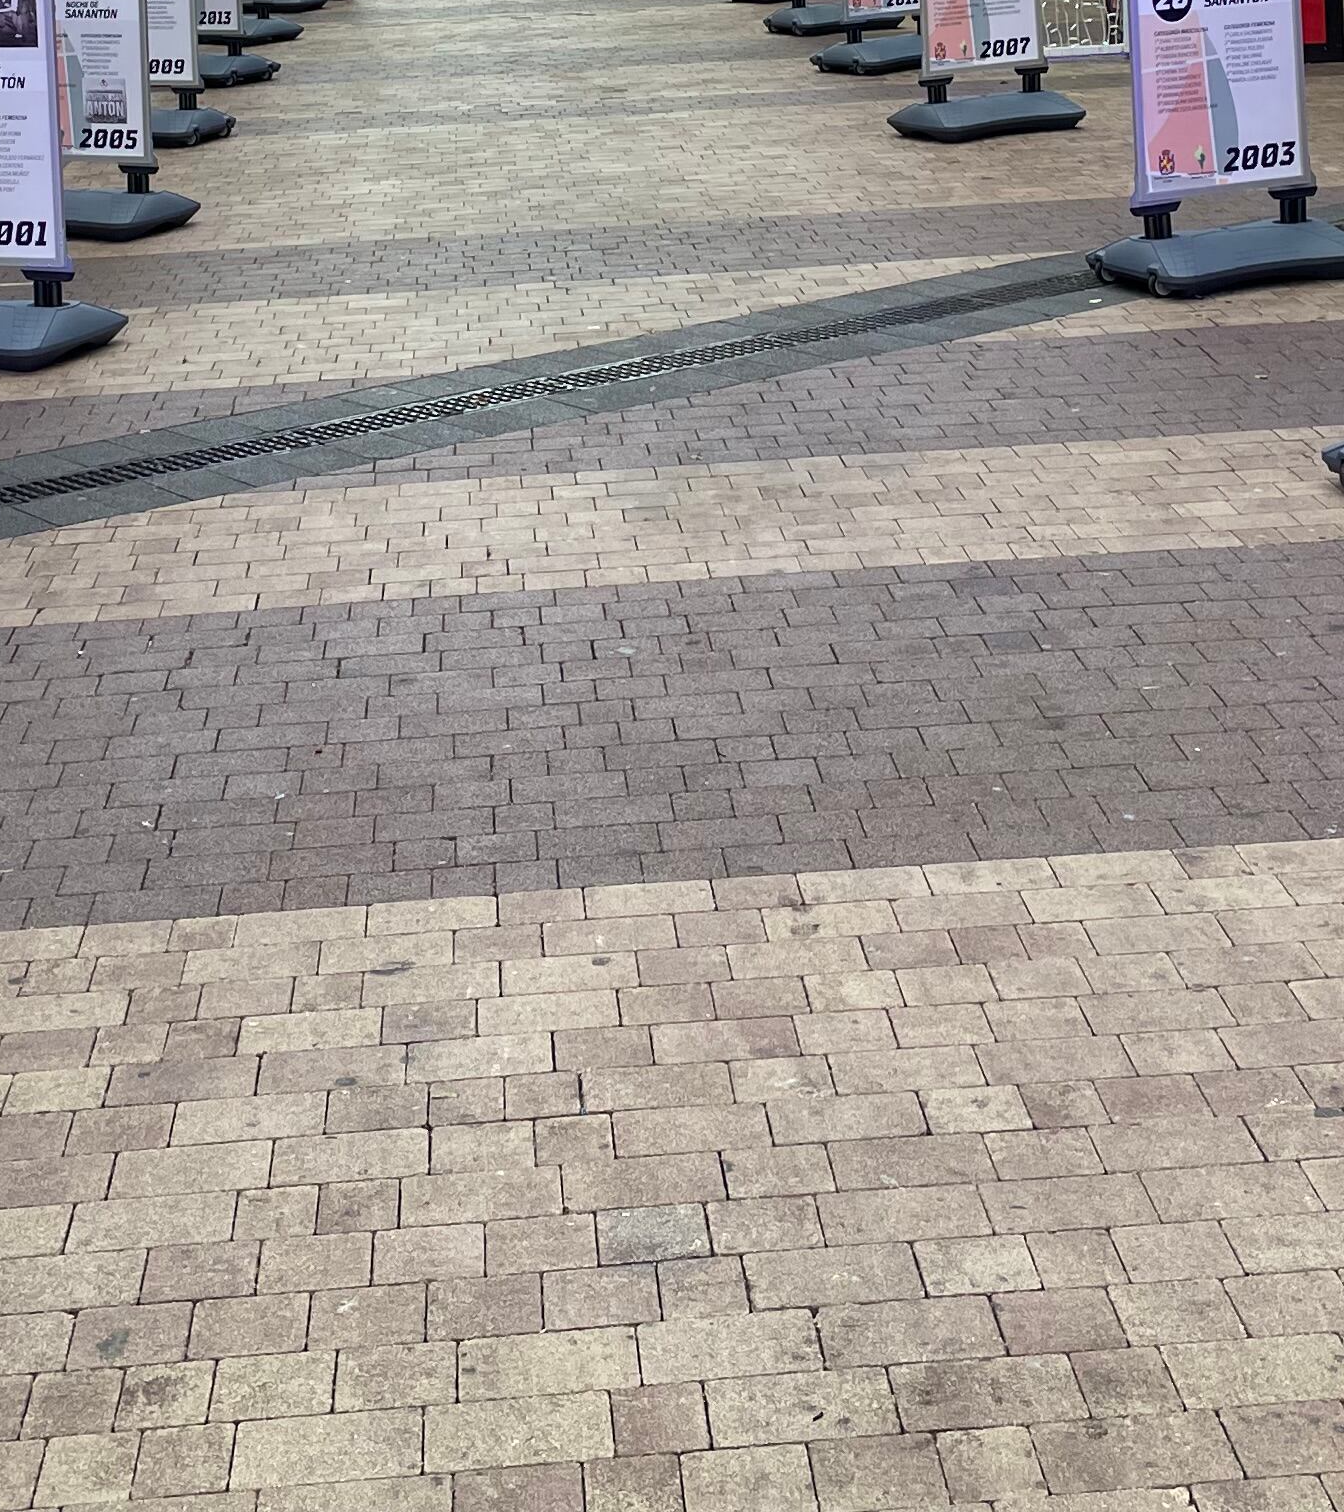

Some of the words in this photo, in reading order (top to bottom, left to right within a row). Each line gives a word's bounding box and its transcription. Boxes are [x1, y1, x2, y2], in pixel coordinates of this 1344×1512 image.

[199, 11, 232, 25] 2013
[980, 37, 1031, 59] 2007
[79, 128, 138, 150] 2005
[1223, 141, 1295, 172] 2003
